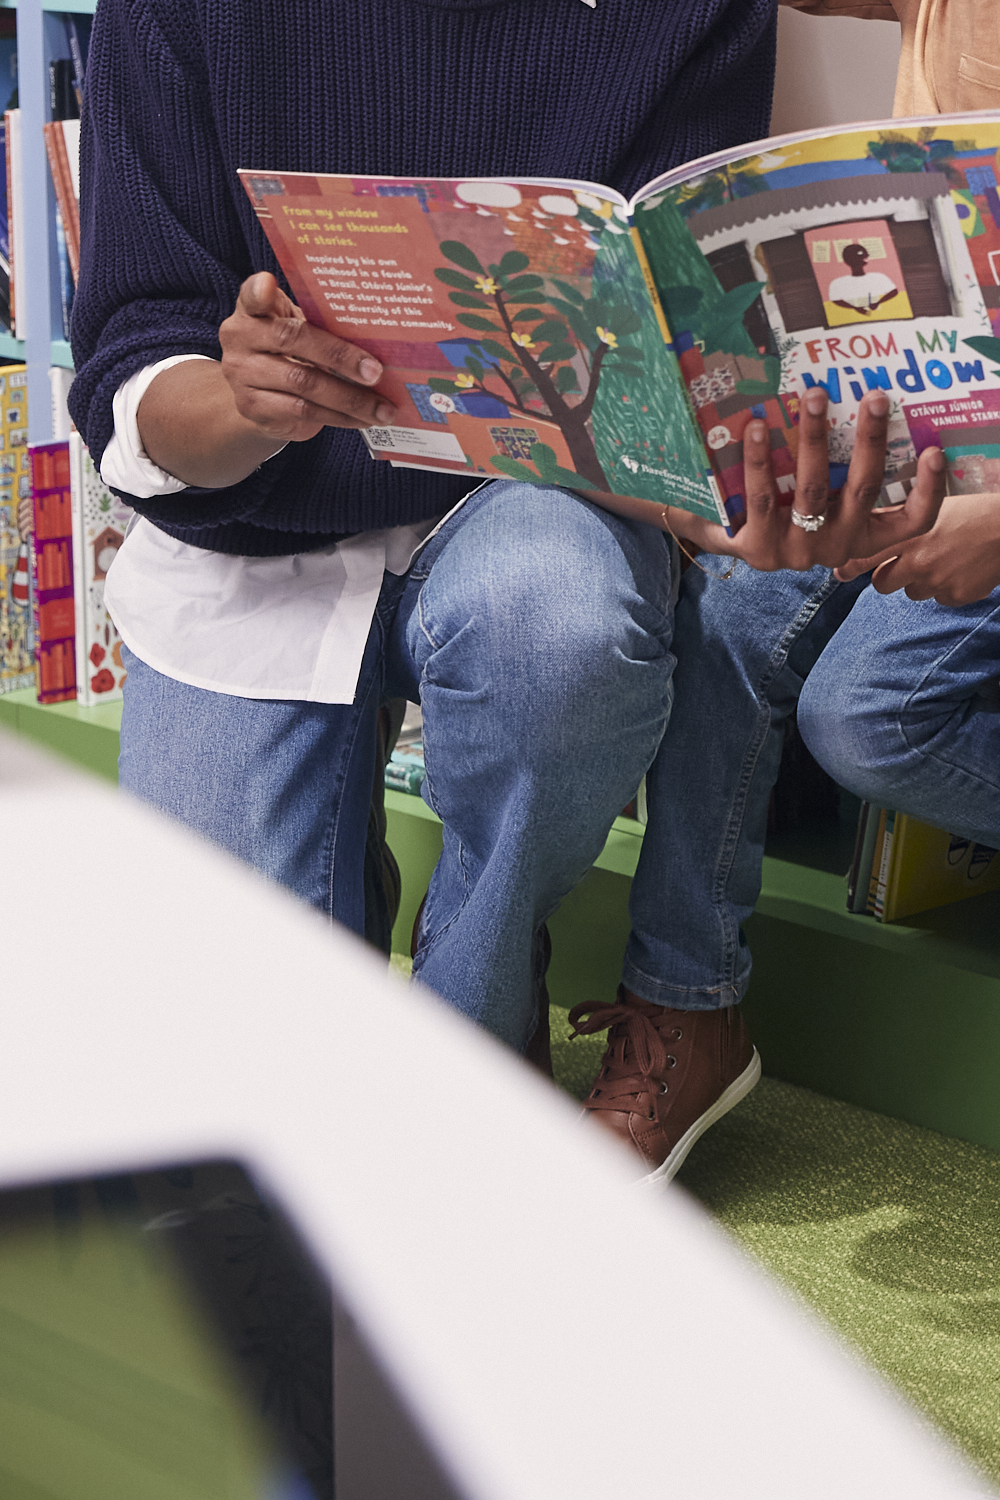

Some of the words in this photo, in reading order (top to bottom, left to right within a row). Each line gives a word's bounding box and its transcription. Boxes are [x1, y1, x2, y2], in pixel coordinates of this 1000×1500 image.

[282, 205, 312, 217] From
[315, 208, 334, 220] my
[336, 206, 379, 219] window
[289, 220, 296, 230] I
[299, 222, 321, 231] can
[323, 223, 343, 232] see
[346, 222, 409, 234] thousands
[297, 234, 310, 245] of
[314, 236, 357, 247] stories.
[305, 254, 344, 265] Inspired
[345, 255, 360, 267] by
[360, 256, 376, 266] his
[378, 258, 398, 267] own
[312, 266, 357, 277] childhood
[359, 268, 370, 278] in
[372, 270, 379, 278] a
[381, 269, 413, 279] favela
[317, 278, 328, 287] in
[329, 279, 360, 290] Brazil,
[361, 279, 394, 291] Otávio
[323, 291, 354, 301] poetic
[356, 292, 382, 304] story
[384, 293, 434, 305] celebrates
[329, 302, 346, 312] the
[348, 304, 390, 316] diversity
[391, 306, 403, 315] of
[403, 306, 423, 316] this
[335, 315, 369, 326] unique
[370, 317, 399, 327] urban
[400, 320, 456, 331] community.
[804, 332, 899, 364] FROM
[915, 329, 958, 354] MY
[910, 403, 947, 418] OTÁVIO
[949, 400, 985, 413] JÚNIOR
[931, 414, 968, 427] VANINA
[641, 463, 682, 482] Barefoot
[683, 475, 712, 495] Books
